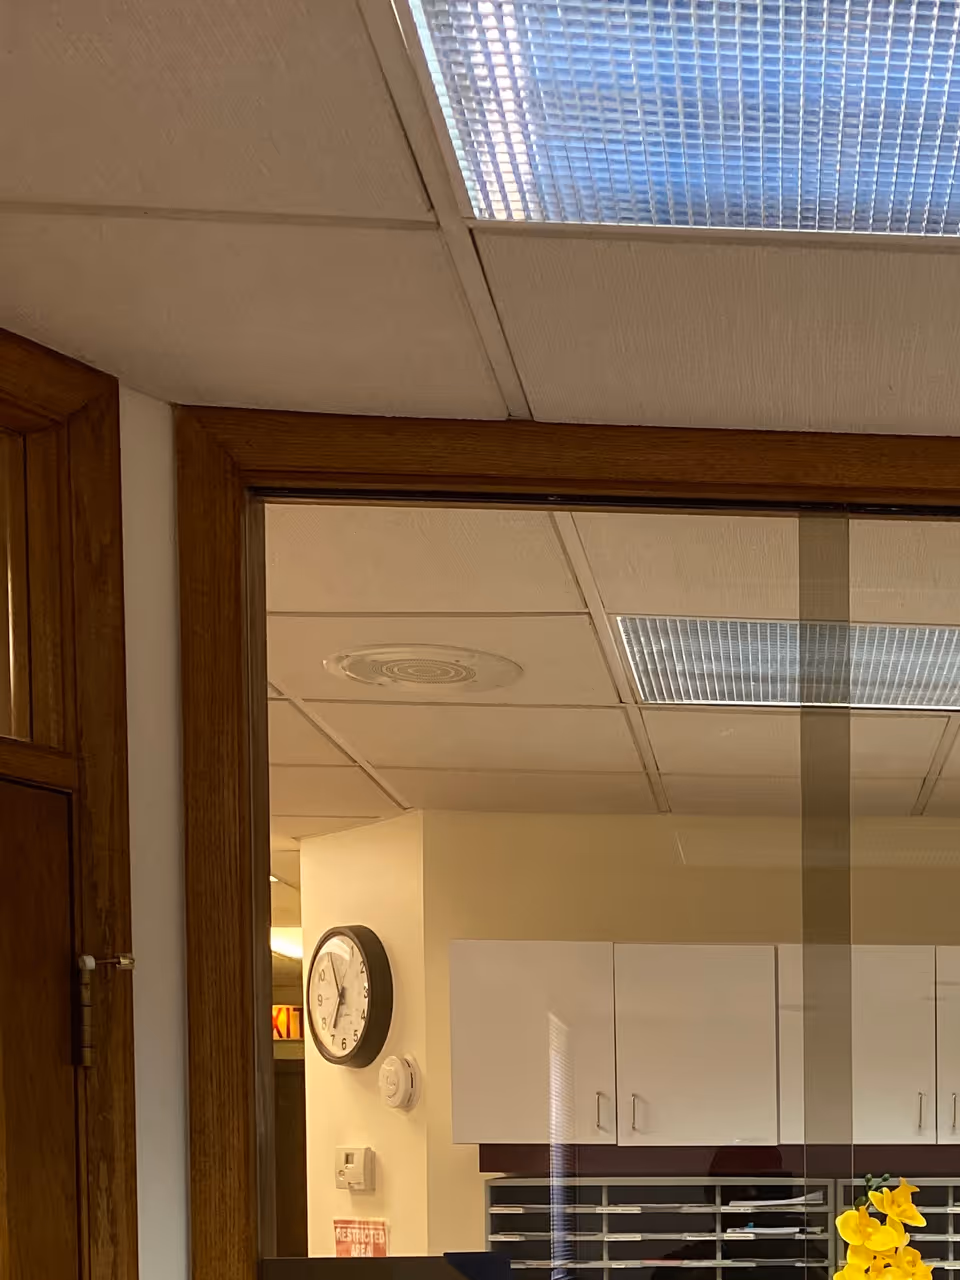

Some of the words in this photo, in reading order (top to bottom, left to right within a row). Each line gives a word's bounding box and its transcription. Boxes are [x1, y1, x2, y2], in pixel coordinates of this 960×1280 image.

[317, 994, 323, 1007] 9
[272, 1006, 304, 1039] XIT
[321, 1018, 327, 1031] 8
[330, 1034, 336, 1046] 7
[353, 1030, 359, 1043] 5
[341, 1038, 347, 1050] 6
[336, 1228, 385, 1243] RESTRICTED
[351, 1244, 372, 1257] AREA
